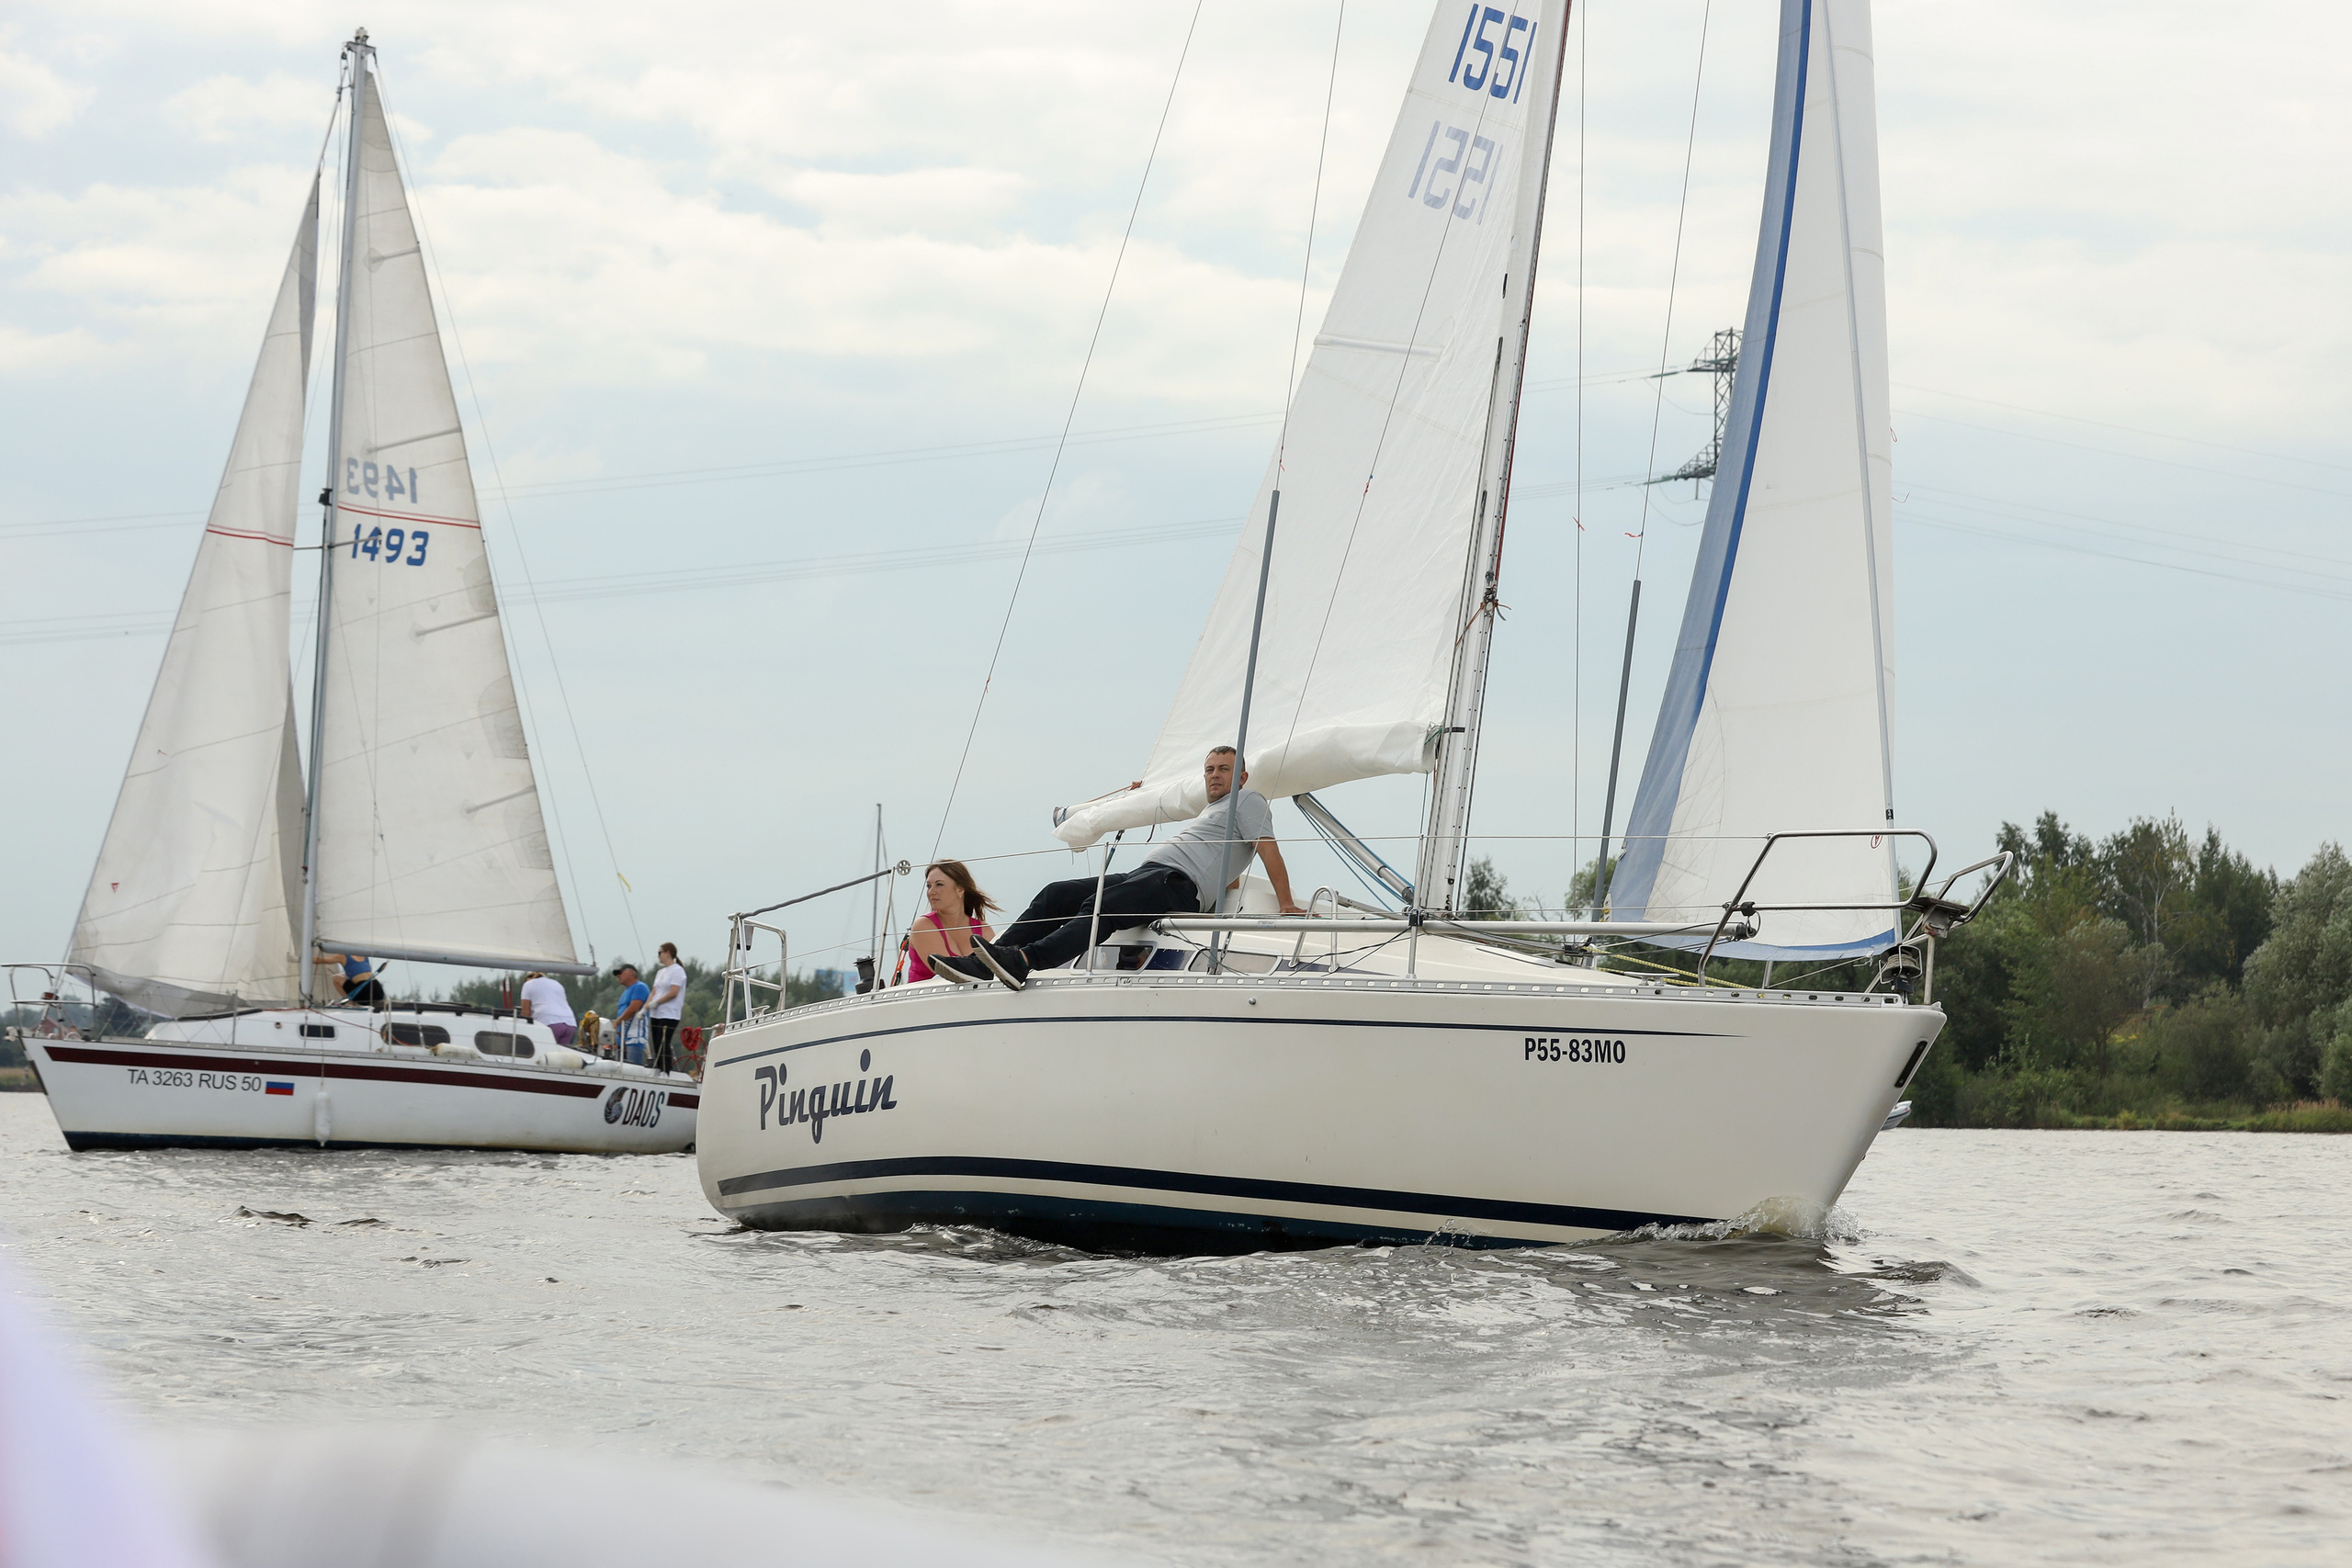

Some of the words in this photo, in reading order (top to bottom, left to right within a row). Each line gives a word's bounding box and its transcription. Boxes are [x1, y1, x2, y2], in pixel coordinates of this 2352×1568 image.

[1448, 3, 1538, 105] 1551
[351, 523, 430, 567] 1493
[127, 1068, 149, 1085] TA
[152, 1070, 193, 1088] 3263
[198, 1073, 237, 1090] RUS
[241, 1076, 262, 1092] 50
[754, 1048, 898, 1145] Pinguin
[622, 1088, 665, 1128] DAOS
